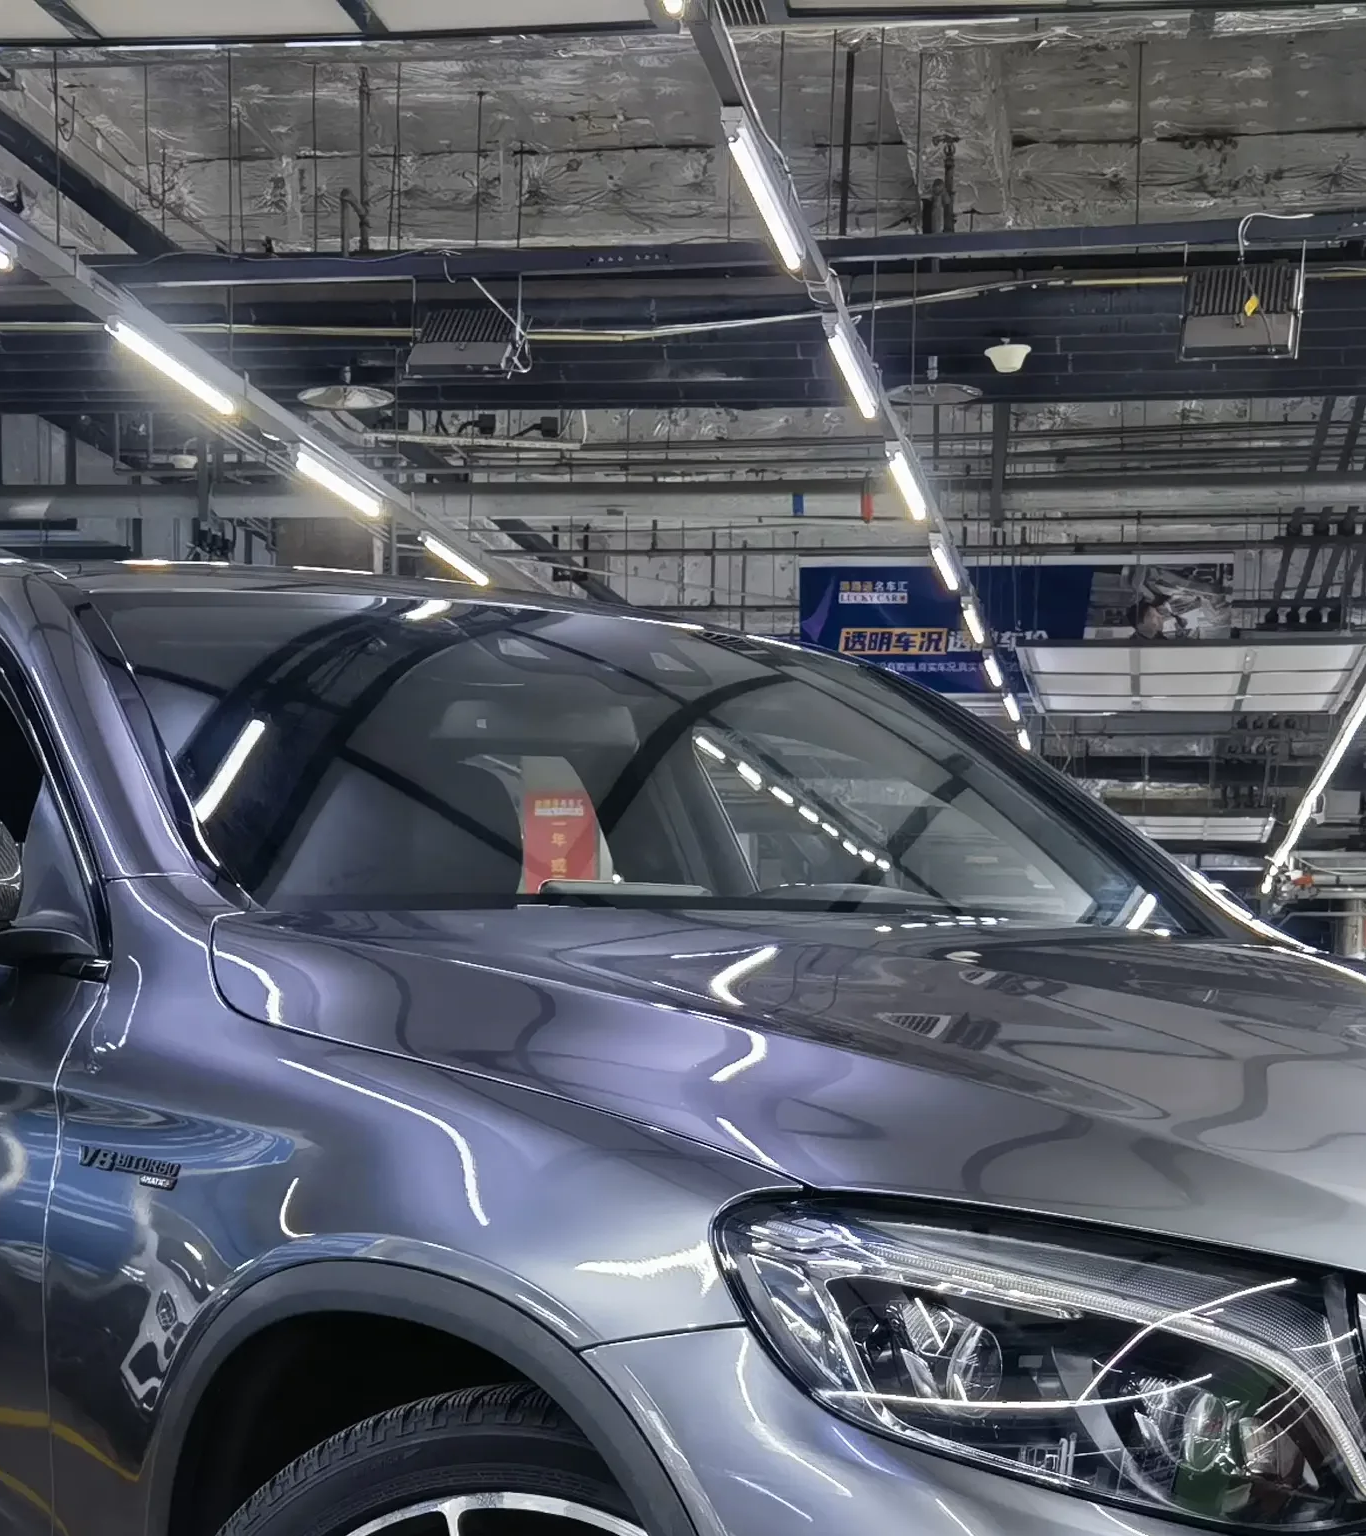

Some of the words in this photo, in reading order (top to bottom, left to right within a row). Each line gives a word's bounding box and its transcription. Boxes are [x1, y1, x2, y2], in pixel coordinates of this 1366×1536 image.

[840, 593, 873, 602] LUCKY
[876, 593, 898, 602] CAR
[843, 631, 943, 653] 透明车况
[79, 1145, 115, 1172] V8
[115, 1151, 181, 1177] BITURBO
